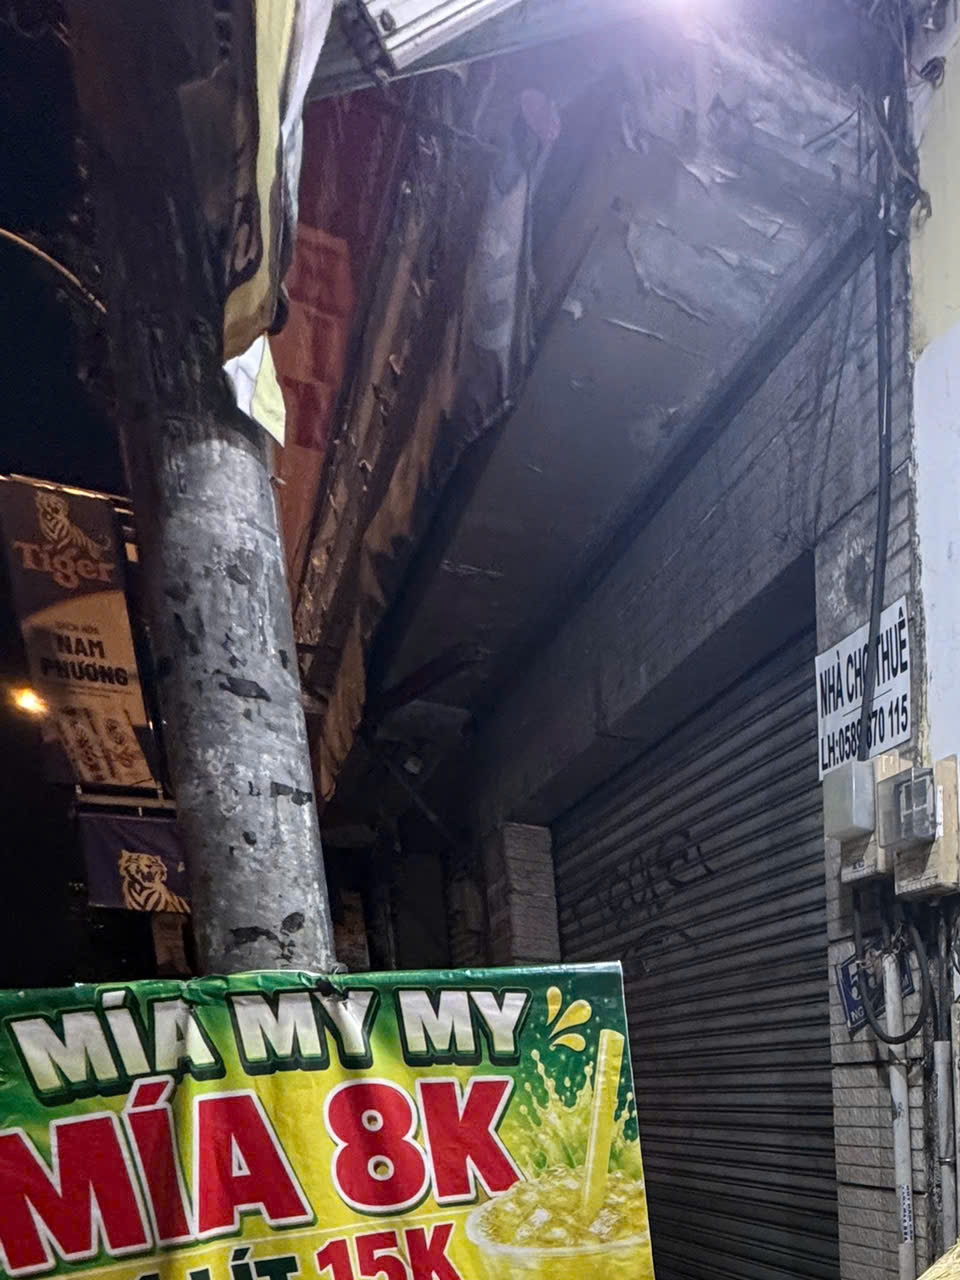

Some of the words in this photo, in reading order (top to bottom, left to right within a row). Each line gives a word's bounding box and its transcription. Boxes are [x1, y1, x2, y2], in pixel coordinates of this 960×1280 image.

[56, 634, 105, 658] NAM
[820, 651, 844, 718] NHÀ
[888, 693, 908, 738] 115
[230, 988, 377, 1066] MY
[396, 988, 530, 1062] MY
[0, 1077, 315, 1277] MÍA
[323, 1076, 526, 1214] 8K
